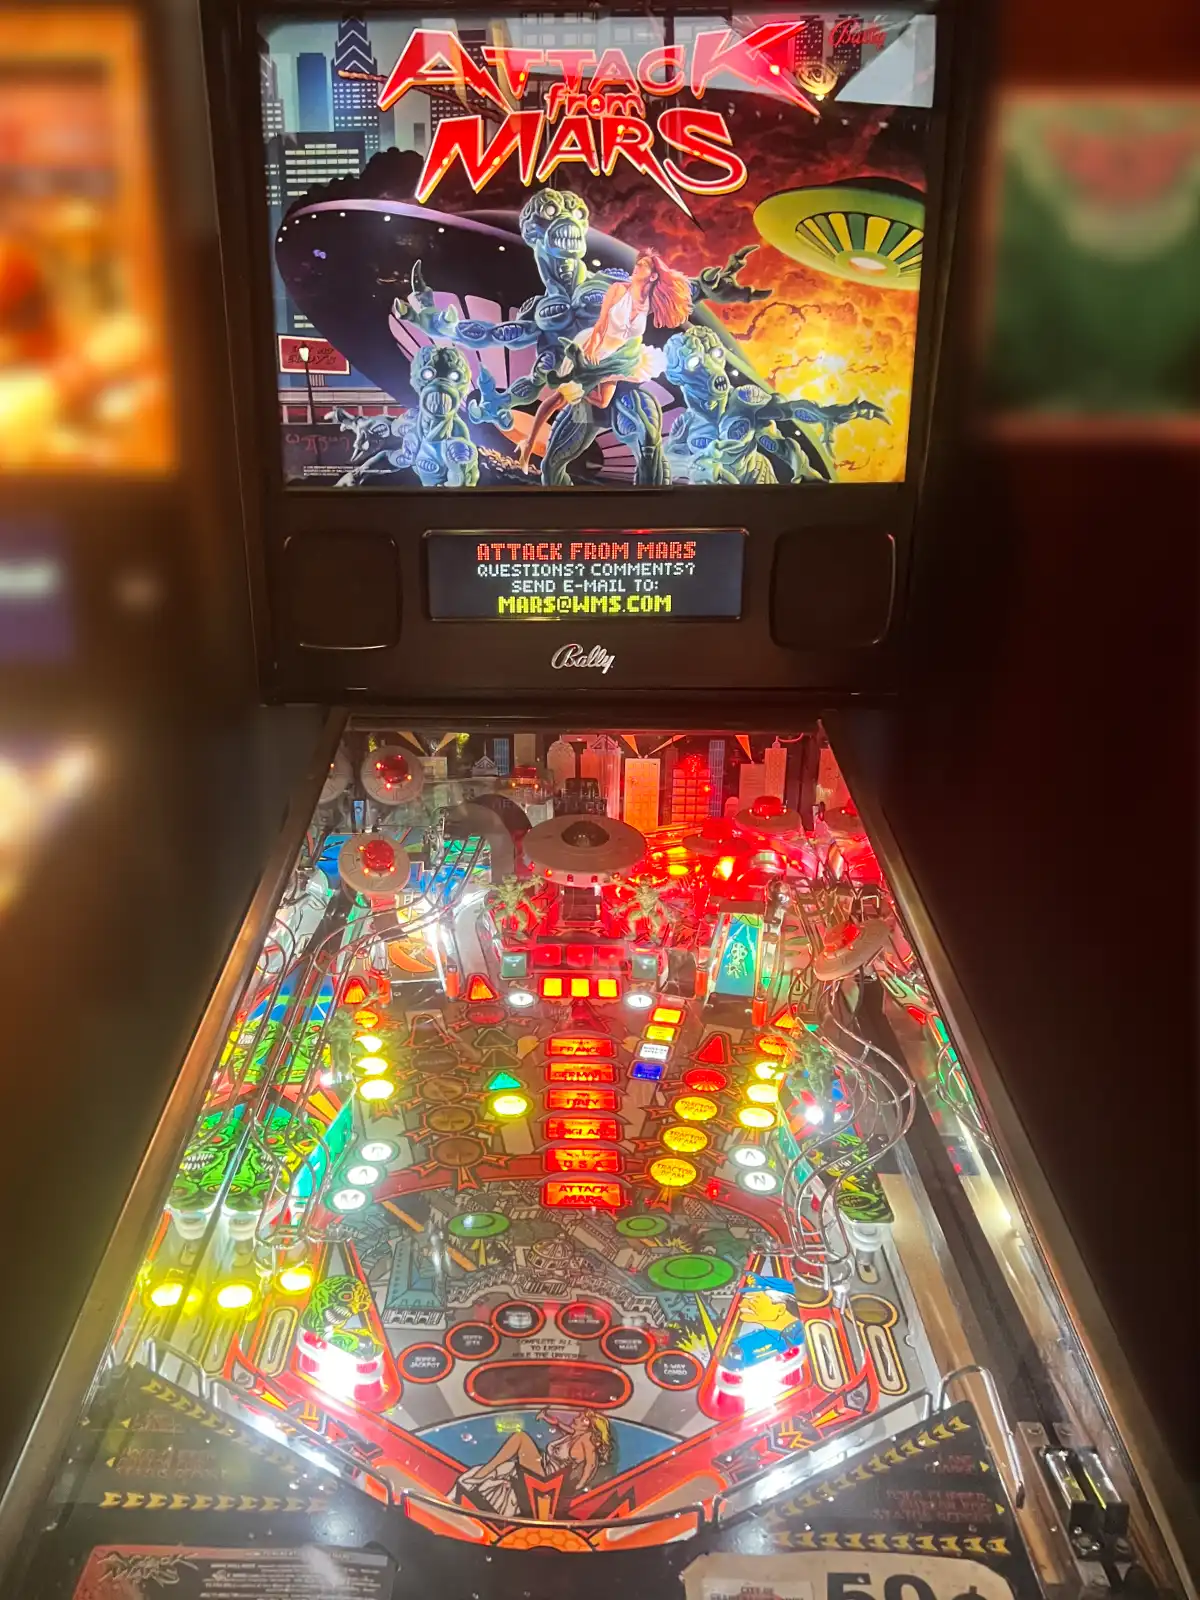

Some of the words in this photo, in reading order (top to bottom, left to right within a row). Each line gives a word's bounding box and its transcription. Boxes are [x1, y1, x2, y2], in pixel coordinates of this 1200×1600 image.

[377, 20, 821, 117] ATTACK
[545, 83, 647, 124] from
[415, 106, 748, 228] MARS
[476, 543, 563, 561] ATTACK
[569, 543, 630, 560] FROM
[636, 541, 697, 559] MARS
[477, 563, 585, 578] QUESTIONS?
[590, 562, 695, 577] COMMENTS?
[511, 580, 556, 593] SEND
[563, 579, 626, 593] E-MAIL
[634, 579, 659, 592] TO:
[498, 594, 673, 614] MARS@WMS.COM
[551, 643, 615, 674] Bally
[559, 1185, 609, 1193] ATTACK
